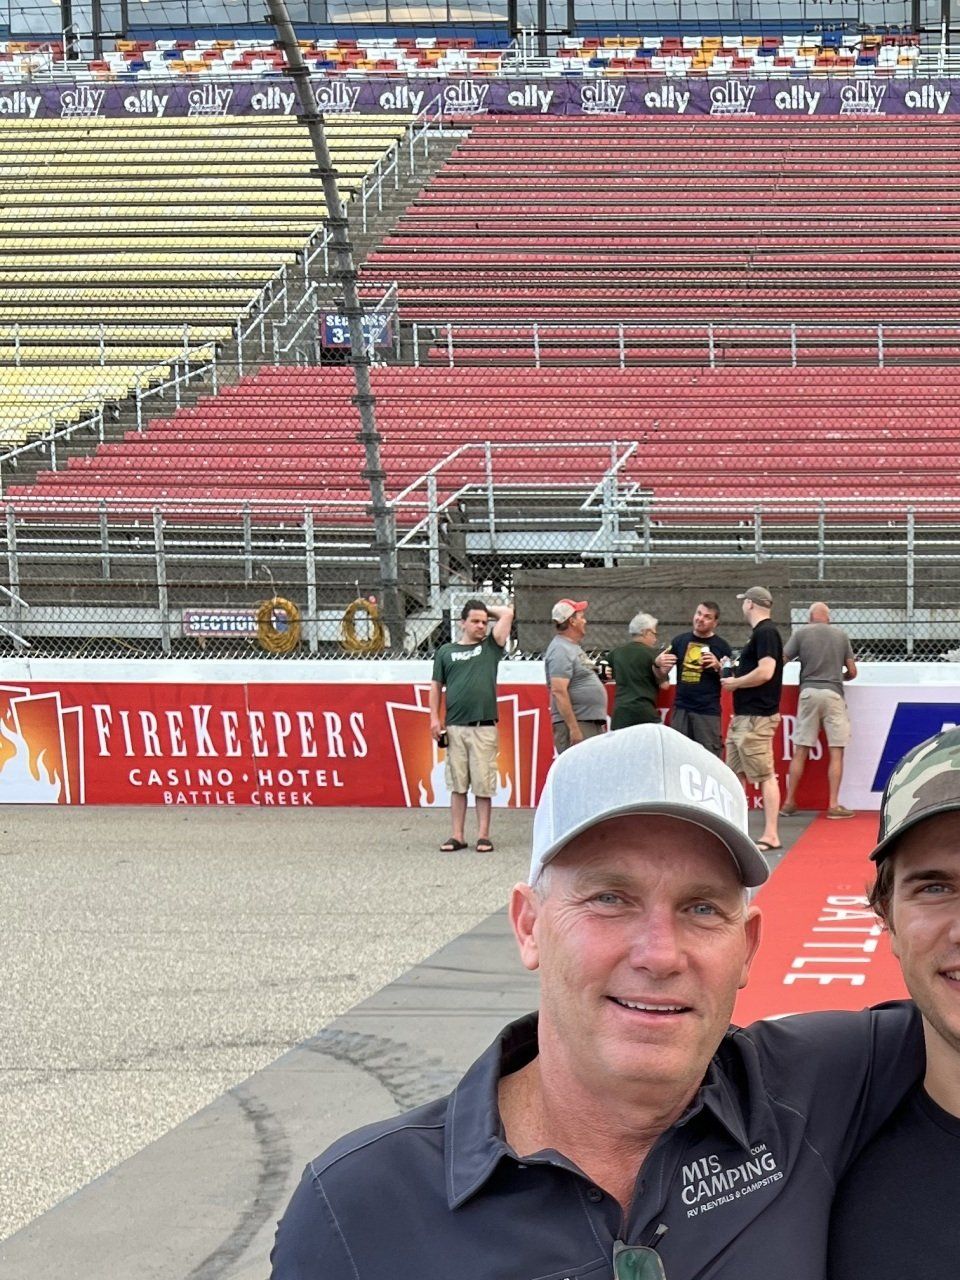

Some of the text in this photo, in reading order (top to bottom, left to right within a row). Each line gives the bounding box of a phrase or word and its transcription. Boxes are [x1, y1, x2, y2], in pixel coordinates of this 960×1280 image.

[0, 91, 41, 118] ally
[61, 85, 105, 116] ally
[124, 90, 169, 117] ally
[188, 84, 233, 115] ally
[250, 87, 296, 115] ally
[315, 82, 360, 112] ally
[379, 86, 424, 113] ally
[444, 80, 489, 112] ally
[508, 85, 553, 113] ally
[581, 80, 626, 112] ally
[644, 86, 690, 113] ally
[710, 80, 755, 113] ally
[775, 85, 820, 114] ally
[840, 80, 886, 113] ally
[905, 85, 950, 113] ally
[189, 615, 259, 632] SECTION
[128, 768, 344, 787] CASINO HOTEL
[680, 763, 734, 819] CAT
[163, 790, 314, 806] BATTLE CREEK
[782, 896, 885, 986] BATTLE
[681, 1152, 777, 1205] CAMPING
[682, 1154, 722, 1186] MIS
[686, 1171, 784, 1218] RV RENTALS & CAMPSITES
